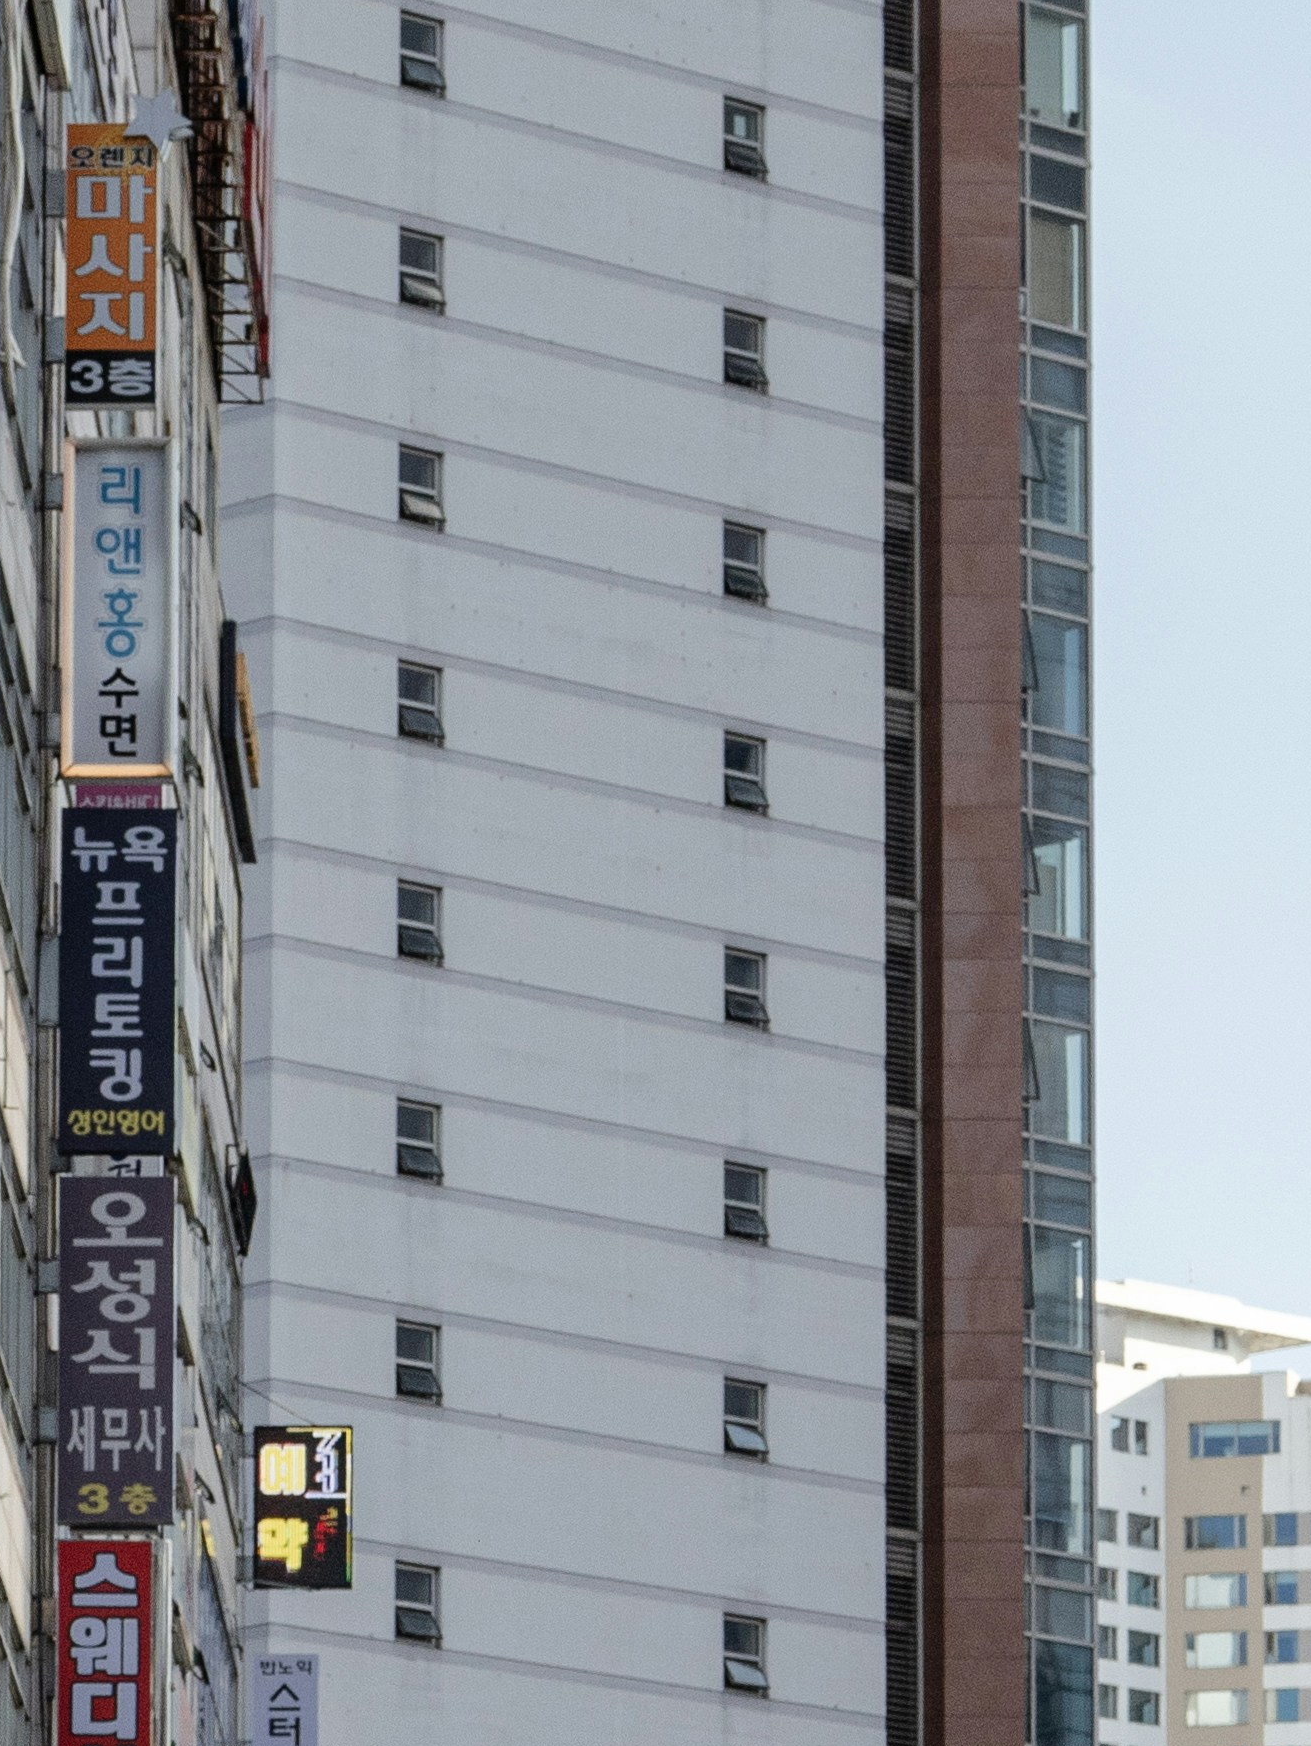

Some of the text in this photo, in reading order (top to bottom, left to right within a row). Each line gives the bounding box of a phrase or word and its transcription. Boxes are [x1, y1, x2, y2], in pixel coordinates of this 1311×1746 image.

[74, 174, 154, 342] 마사지
[70, 360, 153, 397] 3층
[96, 466, 146, 757] 리앤홍 수면
[71, 826, 168, 873] 뉴욕
[88, 882, 146, 1102] 프리토킹
[68, 1110, 165, 1136] 성인영어
[71, 1193, 165, 1390] 오성식
[66, 1405, 166, 1471] 세무사
[77, 1484, 157, 1513] 3층
